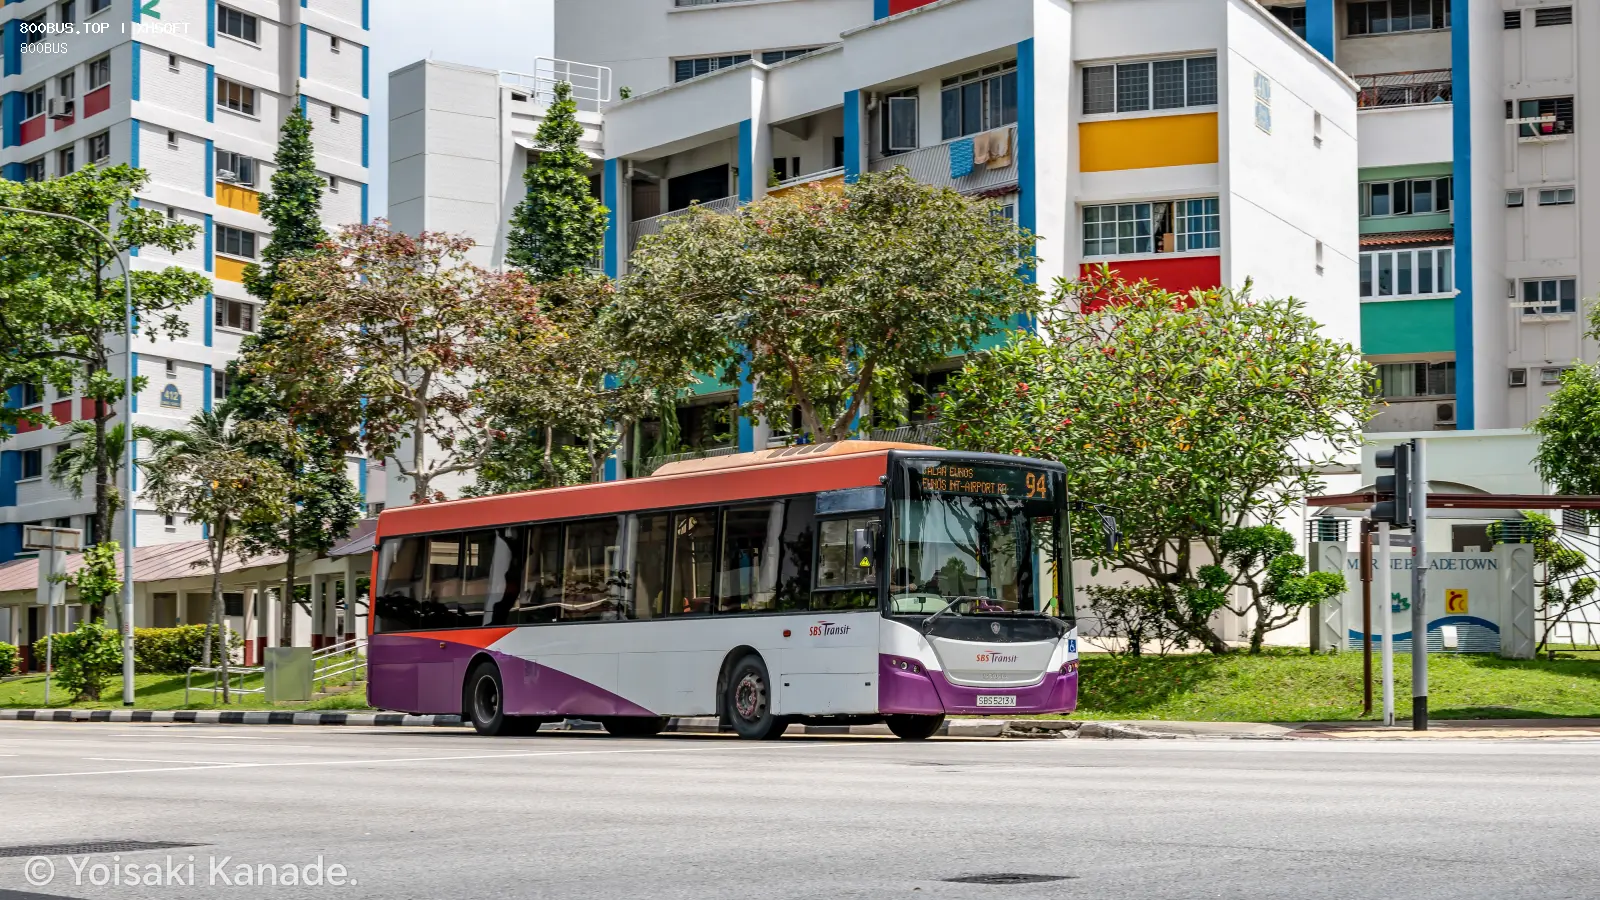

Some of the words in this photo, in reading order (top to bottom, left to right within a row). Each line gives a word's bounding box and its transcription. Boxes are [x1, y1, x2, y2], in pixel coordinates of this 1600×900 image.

[164, 390, 179, 401] 412
[1025, 472, 1047, 499] 94
[1347, 558, 1402, 570] MRE
[1404, 558, 1456, 570] PADE
[1459, 558, 1499, 570] TOWN
[809, 625, 822, 636] SBS
[821, 622, 851, 636] Transit
[976, 654, 990, 662] SBS
[989, 652, 1019, 663] Transit
